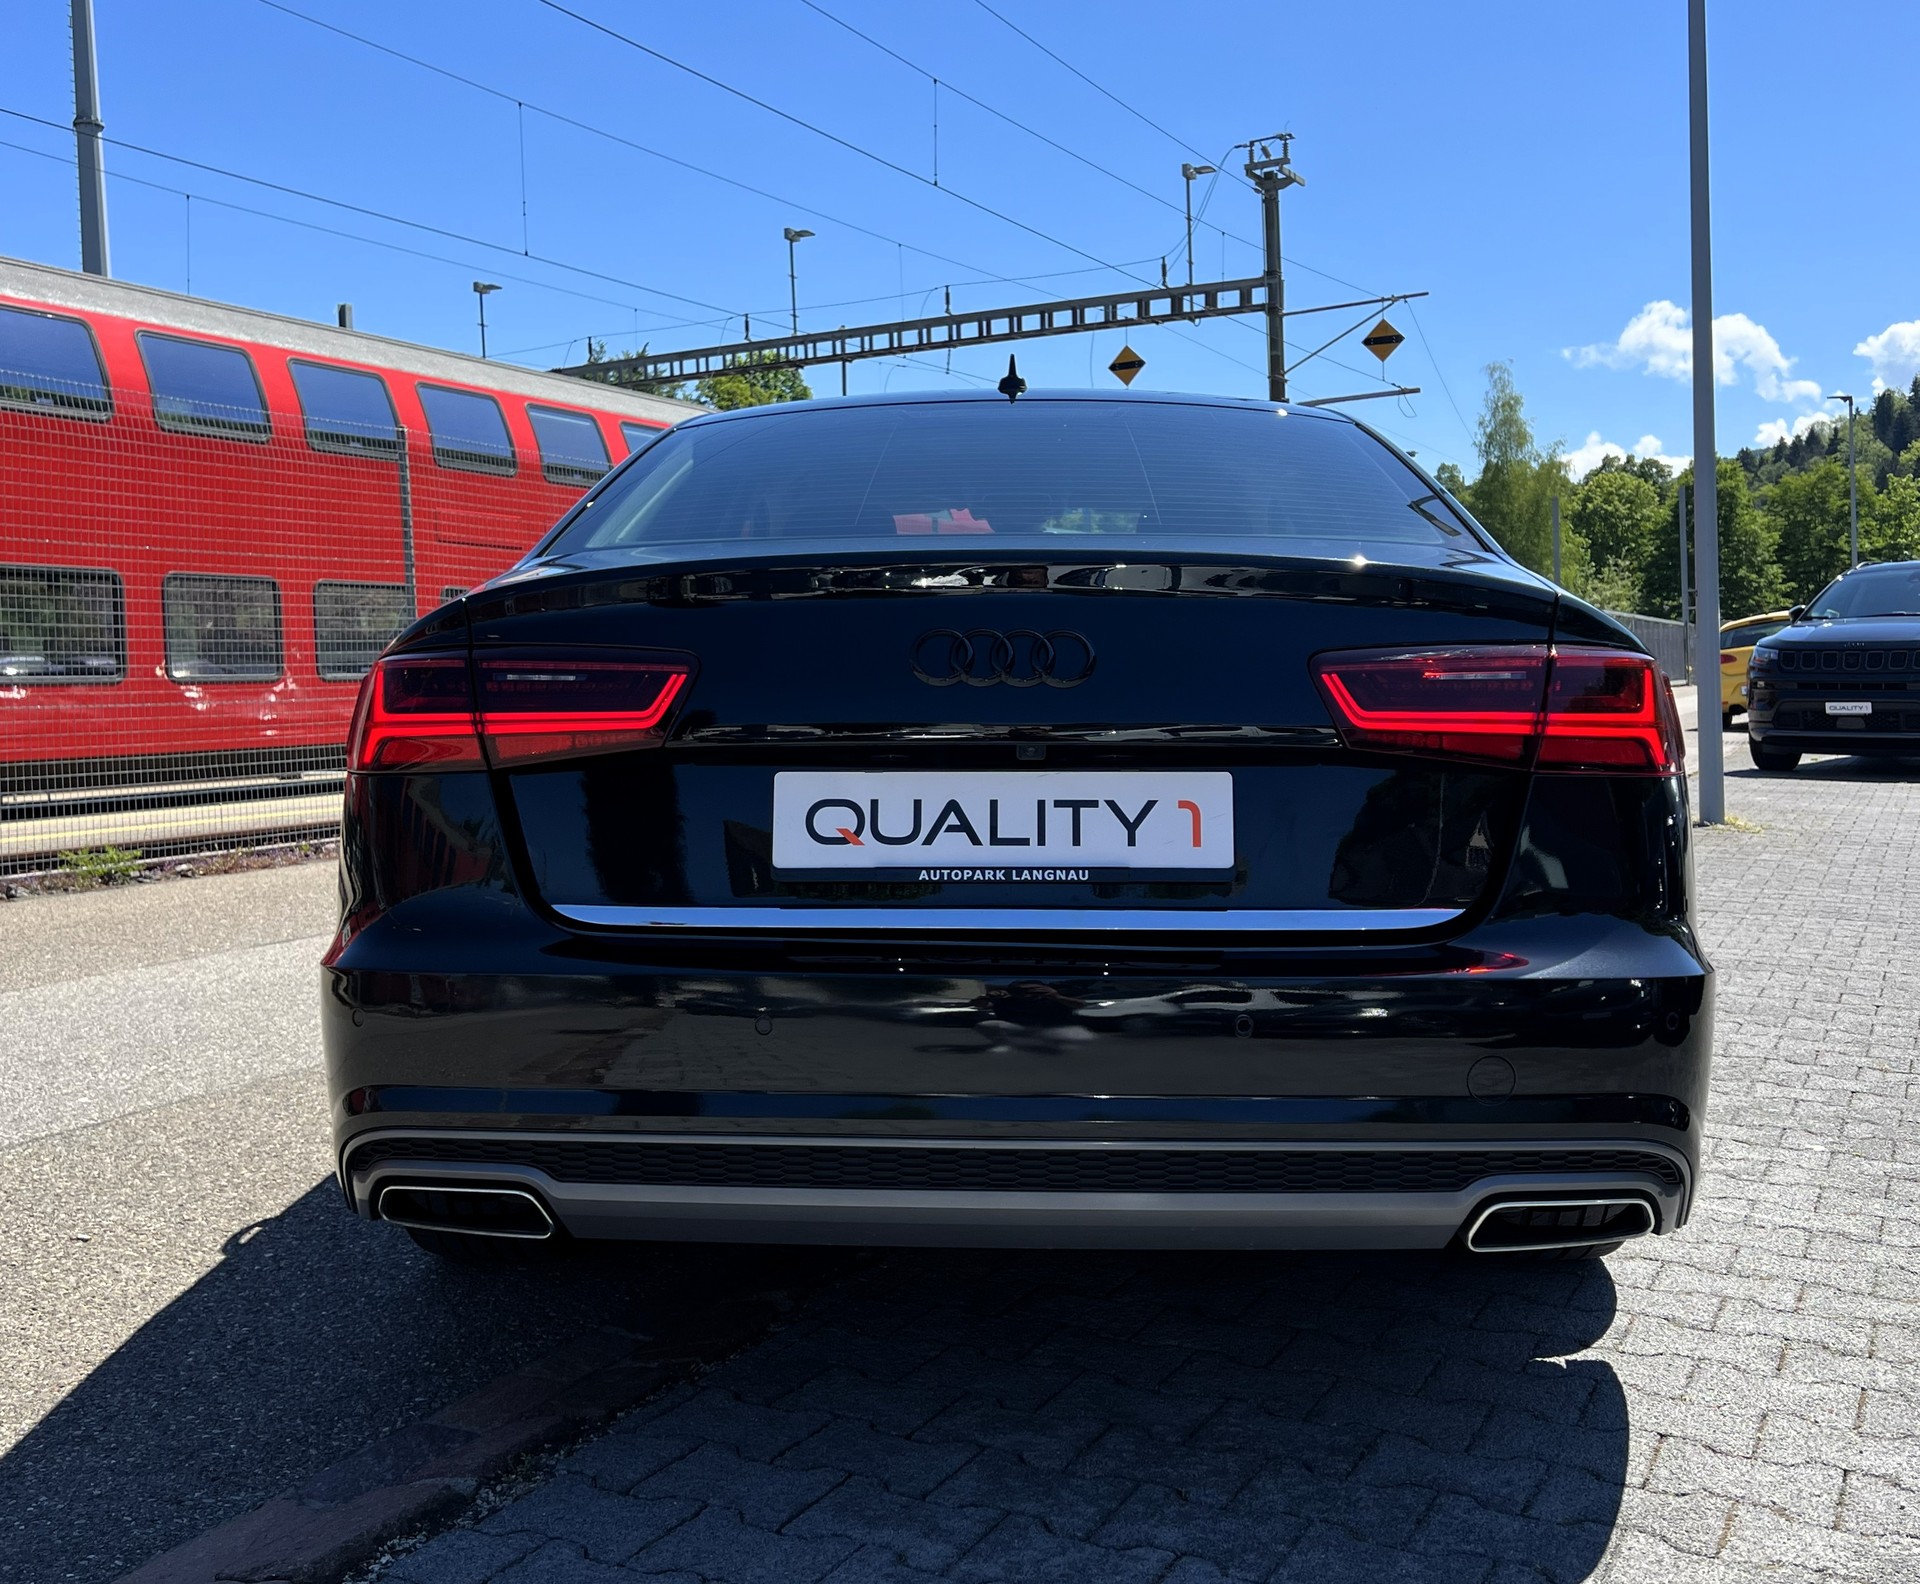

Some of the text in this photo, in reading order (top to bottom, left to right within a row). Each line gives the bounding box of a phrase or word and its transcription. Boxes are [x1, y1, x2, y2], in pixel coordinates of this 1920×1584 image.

[805, 798, 1202, 848] QUALITY 1
[918, 869, 1090, 881] AUTOPARK LANGNAU
